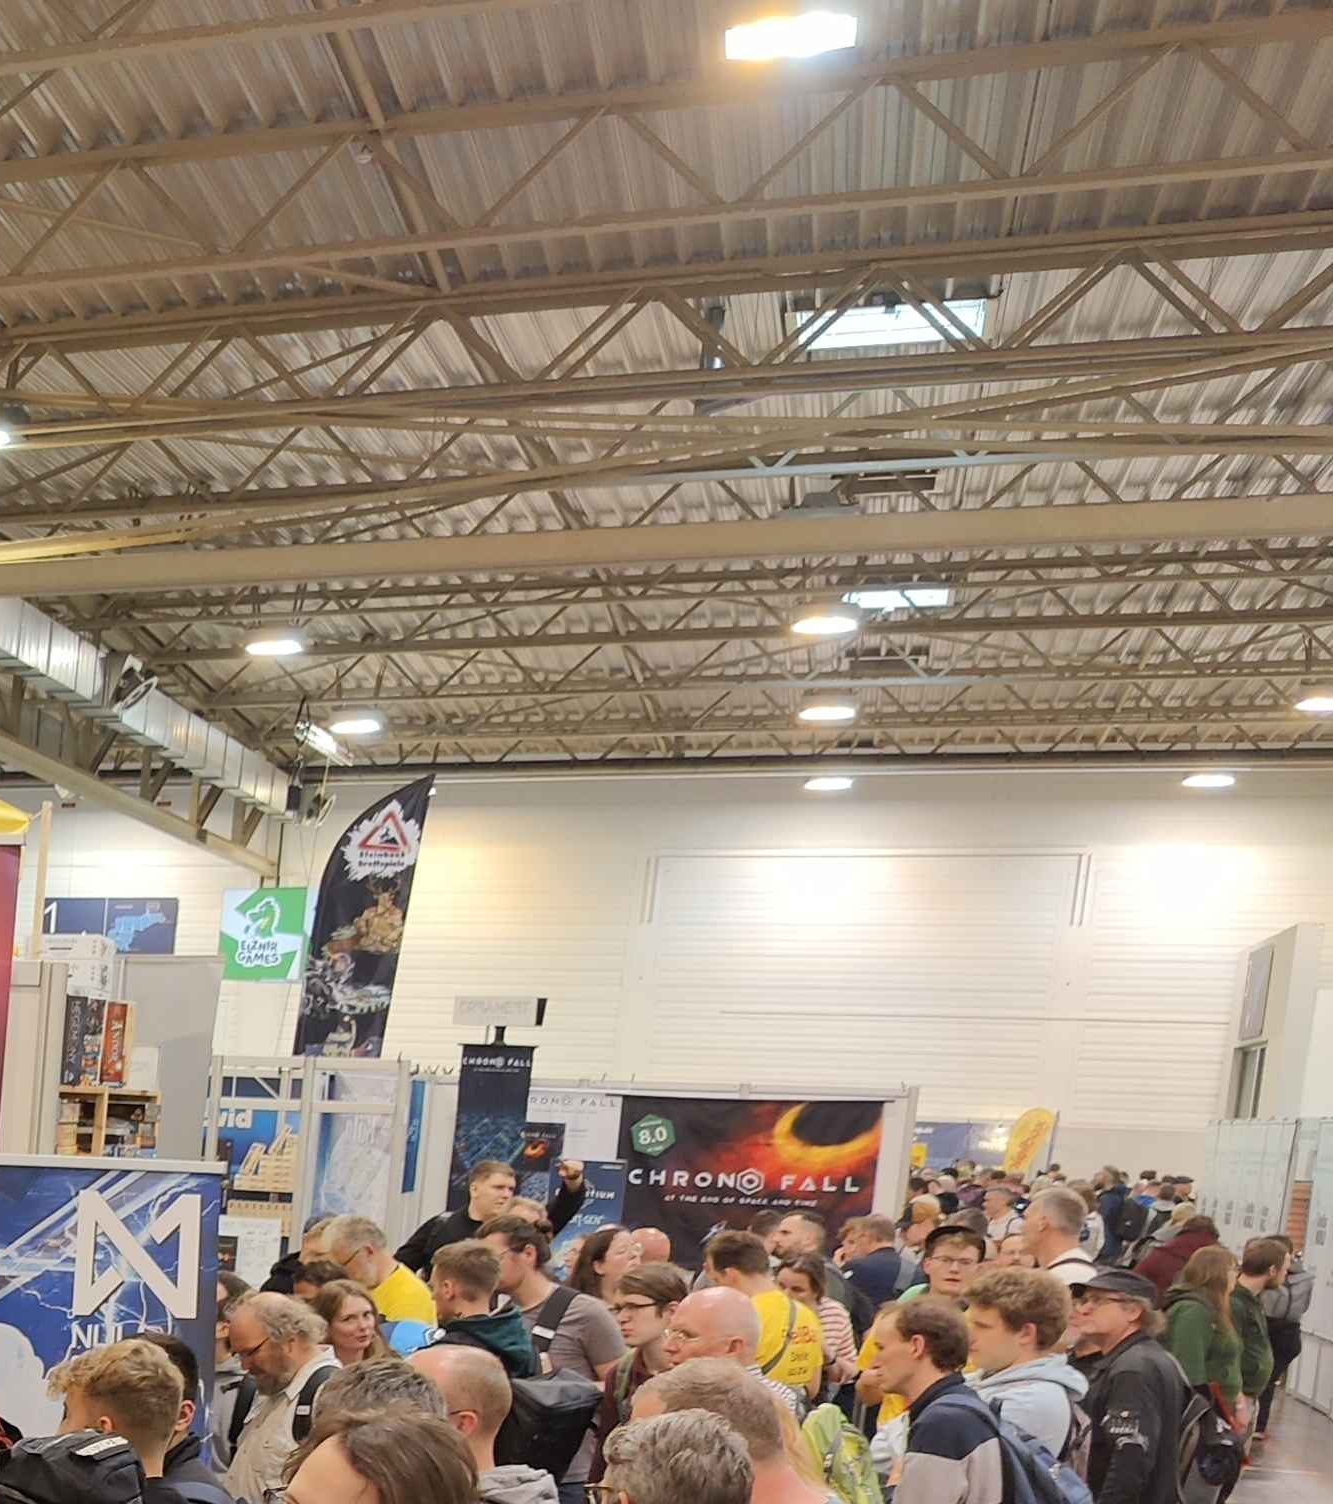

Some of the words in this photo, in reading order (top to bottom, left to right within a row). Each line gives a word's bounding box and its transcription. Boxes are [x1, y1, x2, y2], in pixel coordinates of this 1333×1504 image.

[237, 951, 280, 964] GAMES
[638, 1126, 668, 1145] 8.0
[780, 1174, 861, 1193] FALL
[679, 1195, 697, 1203] THE
